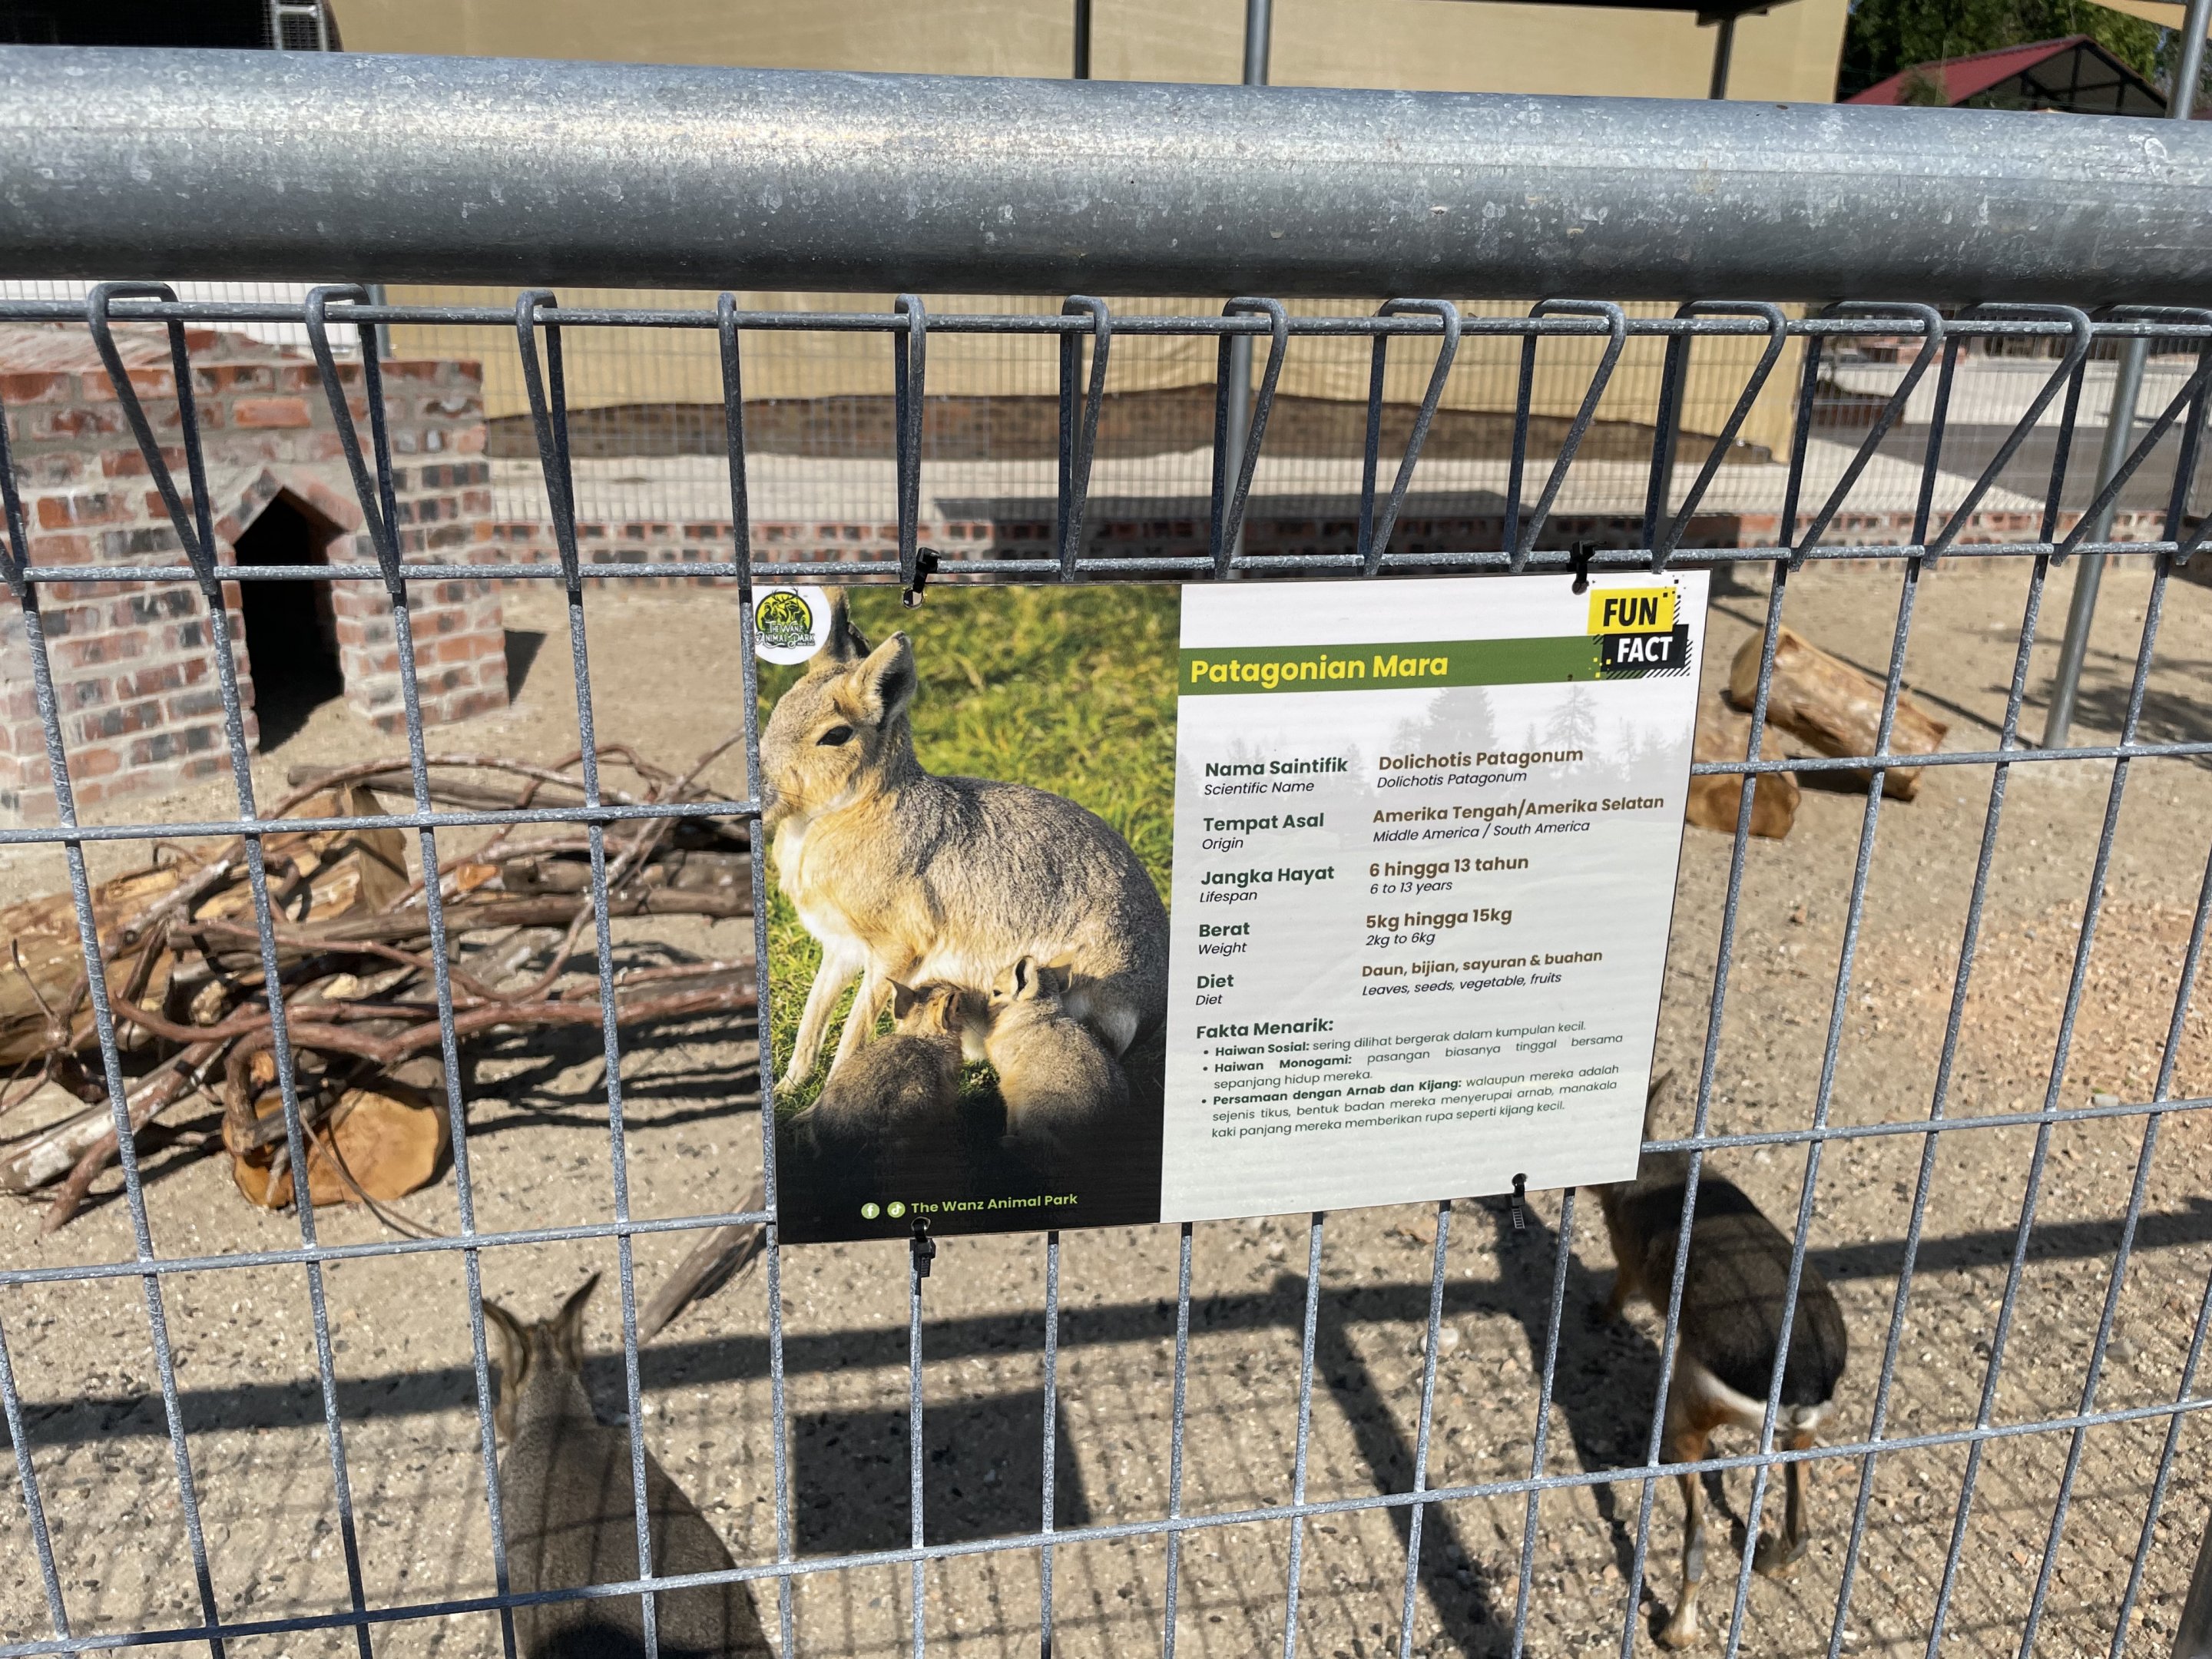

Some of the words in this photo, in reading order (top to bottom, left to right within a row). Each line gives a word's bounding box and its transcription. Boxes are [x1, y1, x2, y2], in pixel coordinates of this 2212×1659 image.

[1603, 597, 1658, 627] FUN
[1617, 636, 1674, 663] FACT
[1191, 654, 1366, 689] Patagonian
[1373, 654, 1449, 677] Mara
[1205, 763, 1265, 777] Nama
[1269, 757, 1349, 775] Saintifik
[1379, 751, 1472, 770] Dolichotis
[1476, 750, 1584, 769] Patagonum
[1204, 782, 1268, 796] Scientific
[1271, 781, 1315, 793] Name
[1376, 774, 1444, 788] Dolichotis
[1447, 772, 1527, 787] Patagonum
[1373, 806, 1449, 823] Amerika
[1452, 798, 1598, 823] Tengah/Amerika
[1601, 796, 1664, 811] Selatan
[1203, 815, 1279, 836] Tempat
[1282, 812, 1324, 829] Asal
[1373, 829, 1419, 843] Middle
[1422, 826, 1480, 840] America
[1482, 823, 1492, 839] /
[1493, 823, 1532, 836] South
[1534, 820, 1591, 834] America
[1202, 836, 1243, 853] Origin
[1200, 869, 1273, 889] Jangka
[1277, 866, 1335, 886] Hayat
[1369, 863, 1380, 877] 6
[1384, 860, 1450, 880] hingga
[1454, 858, 1471, 873] 13
[1475, 856, 1529, 872] tahun
[1200, 890, 1258, 905] Lifespan
[1369, 883, 1379, 895] 6
[1382, 883, 1396, 894] to
[1400, 881, 1413, 893] 13
[1416, 882, 1453, 896] years
[1199, 922, 1250, 938] Berat
[1366, 914, 1399, 932] 5kg
[1404, 911, 1469, 930] hingga
[1472, 908, 1512, 926] 15kg
[1198, 942, 1248, 957] Weight
[1365, 934, 1390, 949] 2kg
[1393, 934, 1408, 945] to
[1411, 932, 1436, 946] 6kg
[1362, 965, 1408, 978] Daun,
[1411, 960, 1459, 978] bijian,
[1462, 957, 1527, 974] sayuran
[1529, 954, 1541, 966] &
[1544, 951, 1603, 965] buahan
[1197, 973, 1234, 989] Diet
[1362, 985, 1410, 996] Leaves,
[1414, 980, 1455, 993] seeds,
[1459, 975, 1526, 992] vegetable,
[1530, 972, 1562, 985] fruits
[1195, 994, 1223, 1006] Diet
[1197, 1024, 1249, 1039] Fakta
[1253, 1017, 1334, 1036] Menarik:
[1215, 1045, 1265, 1057] Haiwan
[1267, 1041, 1310, 1054] Sosial:
[1313, 1039, 1351, 1051] sering
[1353, 1036, 1392, 1048] dilihat
[1395, 1031, 1450, 1047] bergerak
[1452, 1029, 1492, 1041] dalam
[1495, 1025, 1555, 1038] kumpulan
[1558, 1021, 1586, 1032] kecil.
[1214, 1061, 1264, 1073] Haiwan
[1279, 1054, 1353, 1070] Monogami:
[1367, 1051, 1430, 1066] pasangan
[1445, 1045, 1501, 1057] biasanya
[1515, 1038, 1557, 1054] tinggal
[1571, 1035, 1623, 1047] bersama
[1213, 1093, 1288, 1105] Persamaan
[1292, 1089, 1342, 1101] dengan
[1346, 1084, 1386, 1096] Arnab
[1389, 1083, 1415, 1093] dan
[1419, 1079, 1462, 1093] Kijang:
[1466, 1075, 1525, 1087] walaupun
[1529, 1069, 1574, 1081] mereka
[1578, 1065, 1619, 1077] adalah
[1214, 1076, 1281, 1091] sepanjang
[1284, 1074, 1320, 1086] hidup
[1323, 1070, 1373, 1082] mereka.
[1212, 1109, 1255, 1124] sejenis
[1260, 1108, 1291, 1118] tikus,
[1296, 1103, 1339, 1116] bentuk
[1344, 1101, 1385, 1112] badan
[1389, 1097, 1436, 1109] mereka
[1441, 1088, 1512, 1105] menyerupai
[1517, 1086, 1555, 1098] arnab,
[1559, 1080, 1618, 1094] manakala
[1211, 1126, 1237, 1138] kaki
[1239, 1124, 1292, 1139] panjang
[1294, 1120, 1342, 1132] mereka
[1345, 1114, 1422, 1128] memberikan
[1425, 1112, 1453, 1124] rupa
[1455, 1106, 1497, 1121] seperti
[1499, 1104, 1535, 1118] kijang
[1536, 1101, 1565, 1112] kecil.
[911, 1202, 939, 1214] The
[942, 1200, 984, 1212] Wanz
[987, 1195, 1041, 1209] Animal
[1045, 1193, 1078, 1206] Park
